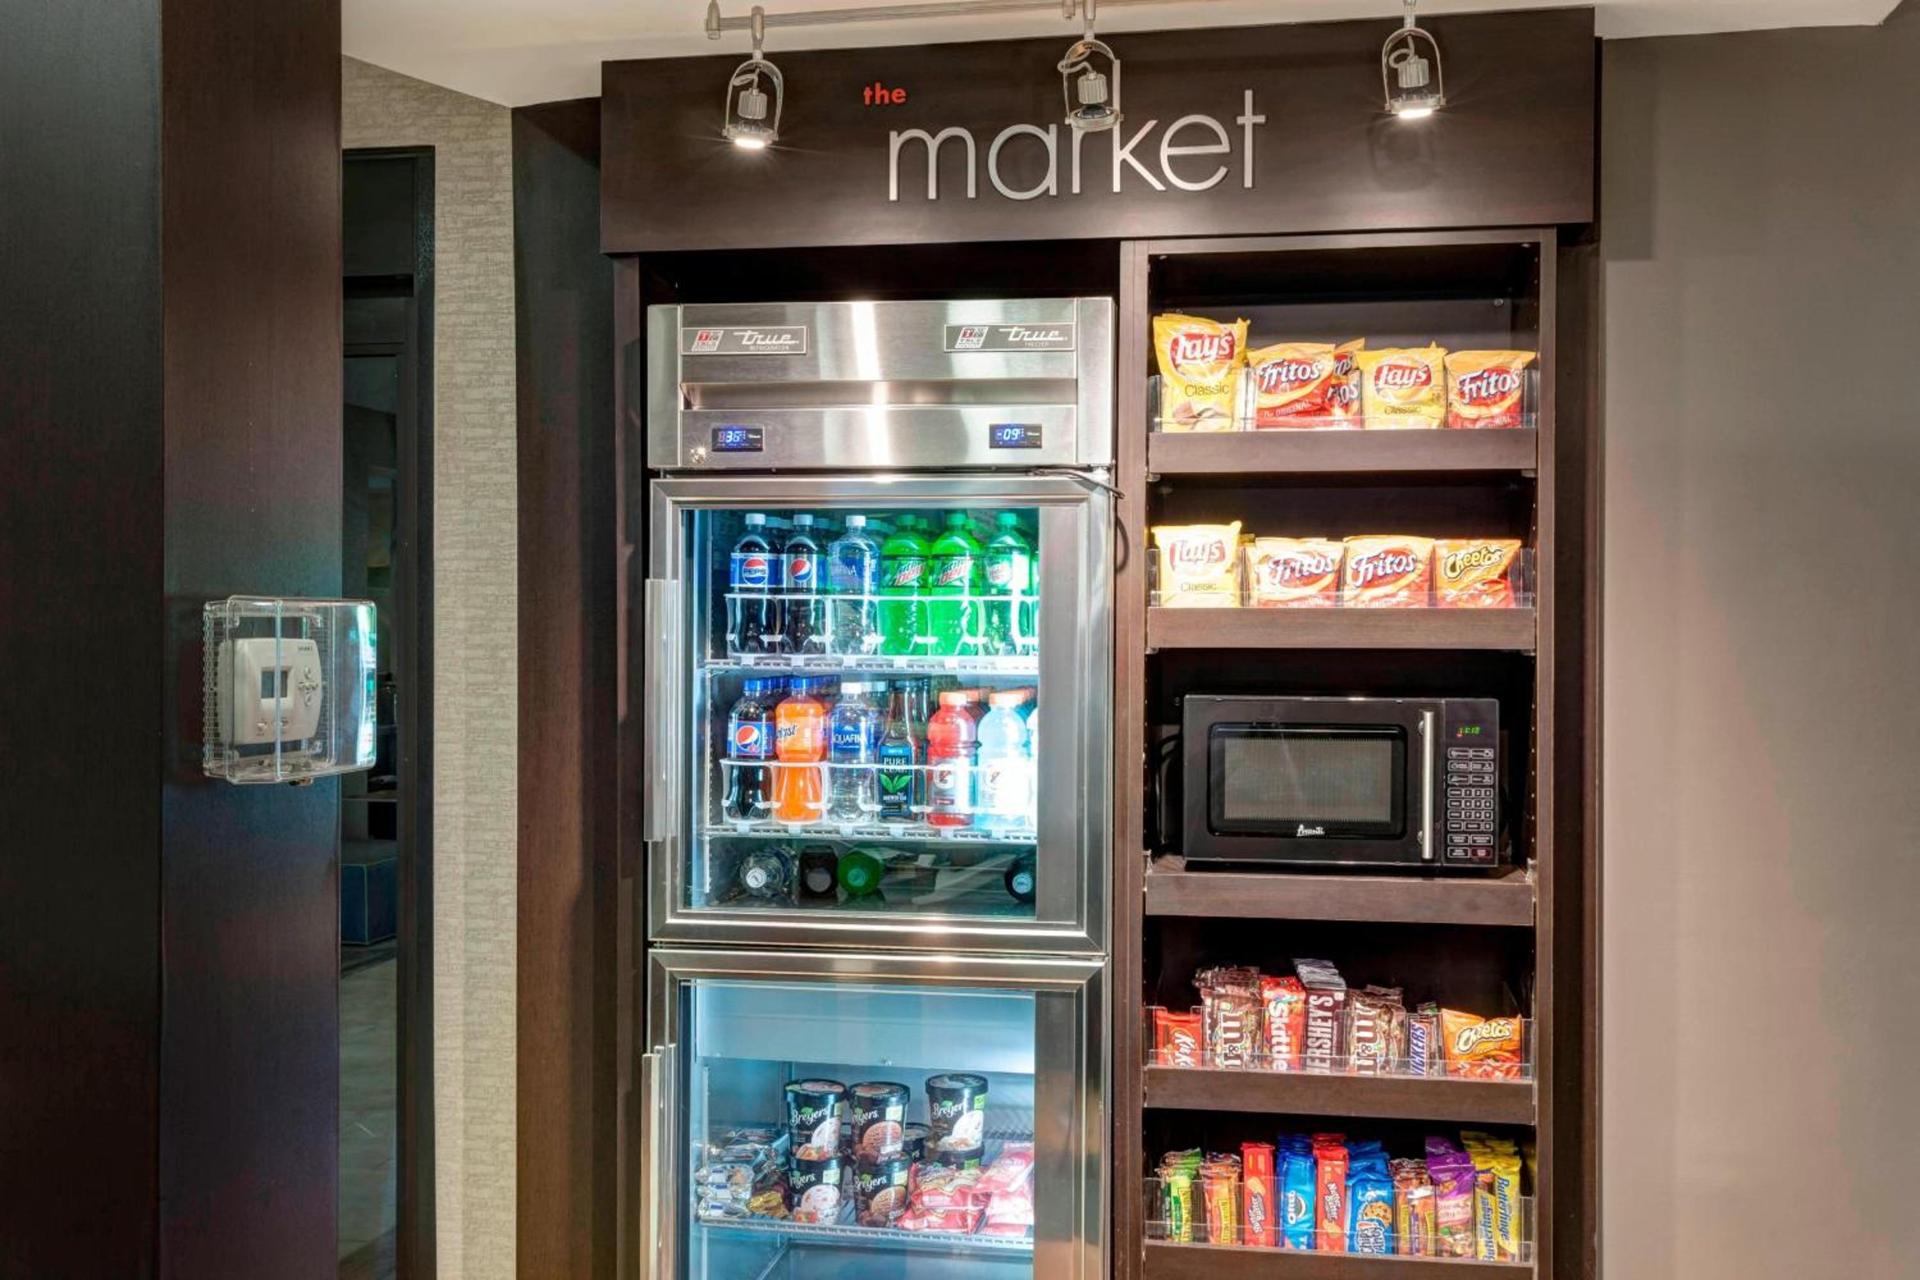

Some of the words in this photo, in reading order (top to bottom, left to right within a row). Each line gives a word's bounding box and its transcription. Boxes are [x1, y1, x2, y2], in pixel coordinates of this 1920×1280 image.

[863, 82, 907, 106] the
[888, 60, 1266, 200] market
[1184, 382, 1230, 398] Classic
[1259, 358, 1325, 391] Fritos
[1456, 367, 1522, 404] Fritos
[1351, 550, 1418, 588] Fritos
[1443, 544, 1505, 579] Cheetos
[1268, 1001, 1291, 1070] Skittle
[1456, 1018, 1513, 1055] Cheetos
